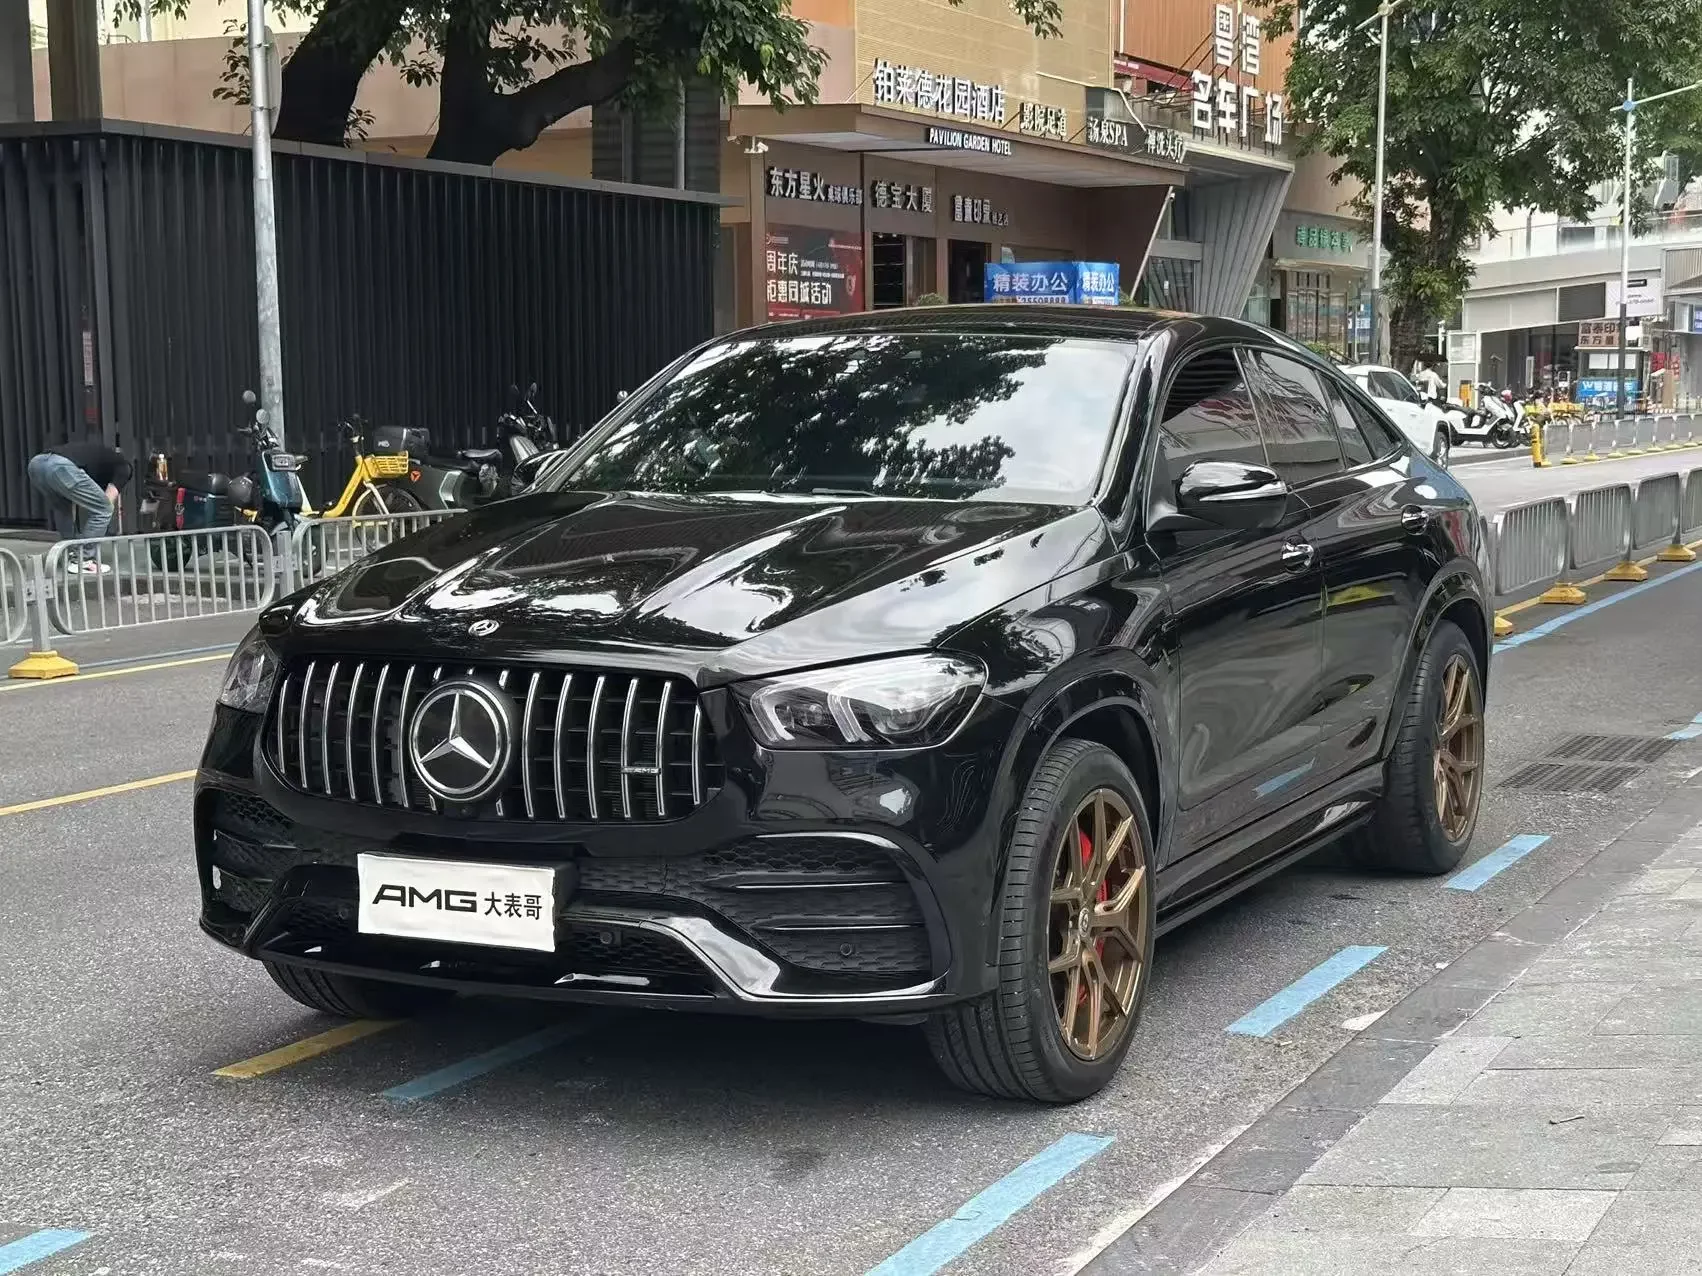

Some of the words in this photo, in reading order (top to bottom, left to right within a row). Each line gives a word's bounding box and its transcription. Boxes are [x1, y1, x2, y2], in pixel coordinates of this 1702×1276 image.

[1215, 3, 1260, 75] 粤湾
[873, 57, 1006, 125] 铂莱德花园酒店
[1192, 69, 1282, 144] 名车广场
[929, 127, 963, 148] PAVILION
[963, 133, 990, 152] GARDEN
[992, 140, 1012, 156] HOTEL
[769, 166, 826, 201] 东方星火
[875, 180, 933, 213] 德宝大厦
[766, 250, 799, 275] 周年庆
[993, 272, 1069, 293] 精装办公
[1082, 271, 1115, 293] 精装办公
[372, 883, 478, 913] AMG
[484, 891, 543, 921] 大表哥
